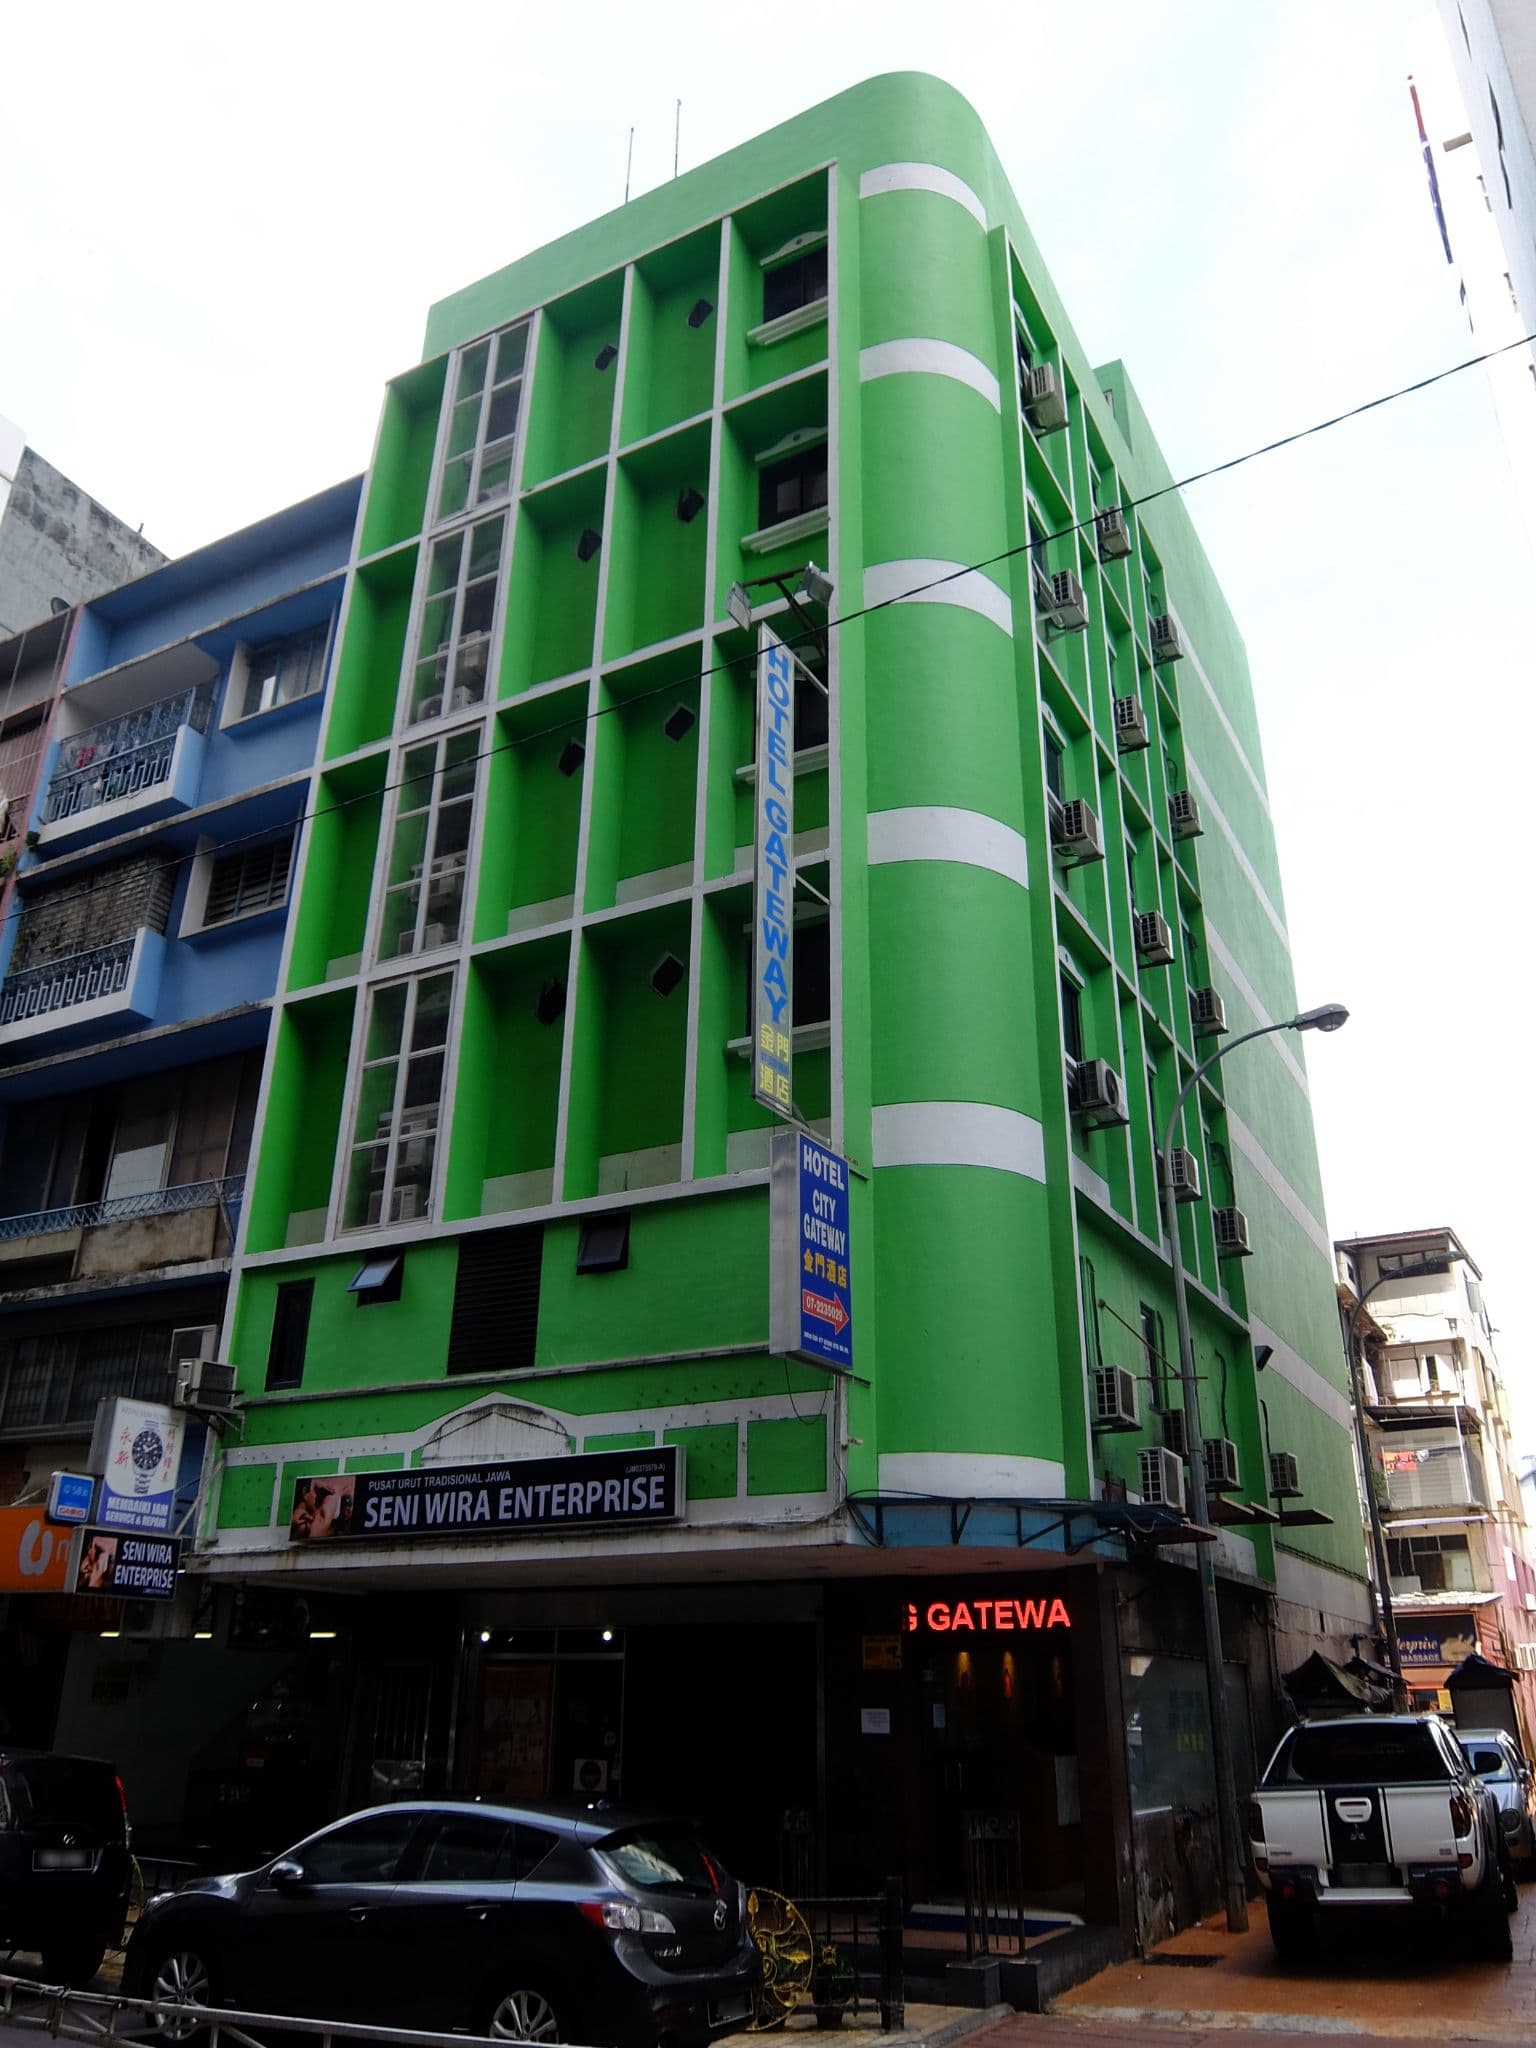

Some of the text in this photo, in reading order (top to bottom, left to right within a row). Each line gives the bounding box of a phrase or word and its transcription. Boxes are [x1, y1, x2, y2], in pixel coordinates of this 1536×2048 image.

[768, 641, 790, 797] HOTEL
[762, 797, 789, 1024] GATEWAY
[803, 1144, 845, 1191] HOTEL
[812, 1187, 836, 1223] CITY
[803, 1213, 846, 1257] GATEWAY
[803, 1247, 847, 1289] 金門酒店
[364, 1475, 665, 1528] SENI WIRA ENTERPRISE
[368, 1469, 511, 1492] PUSAT URUT TRADISIONAL JAWA
[122, 1540, 172, 1564] SENI WIRA
[114, 1565, 174, 1589] ENTERPRISE
[927, 1599, 1071, 1631] GATEWA
